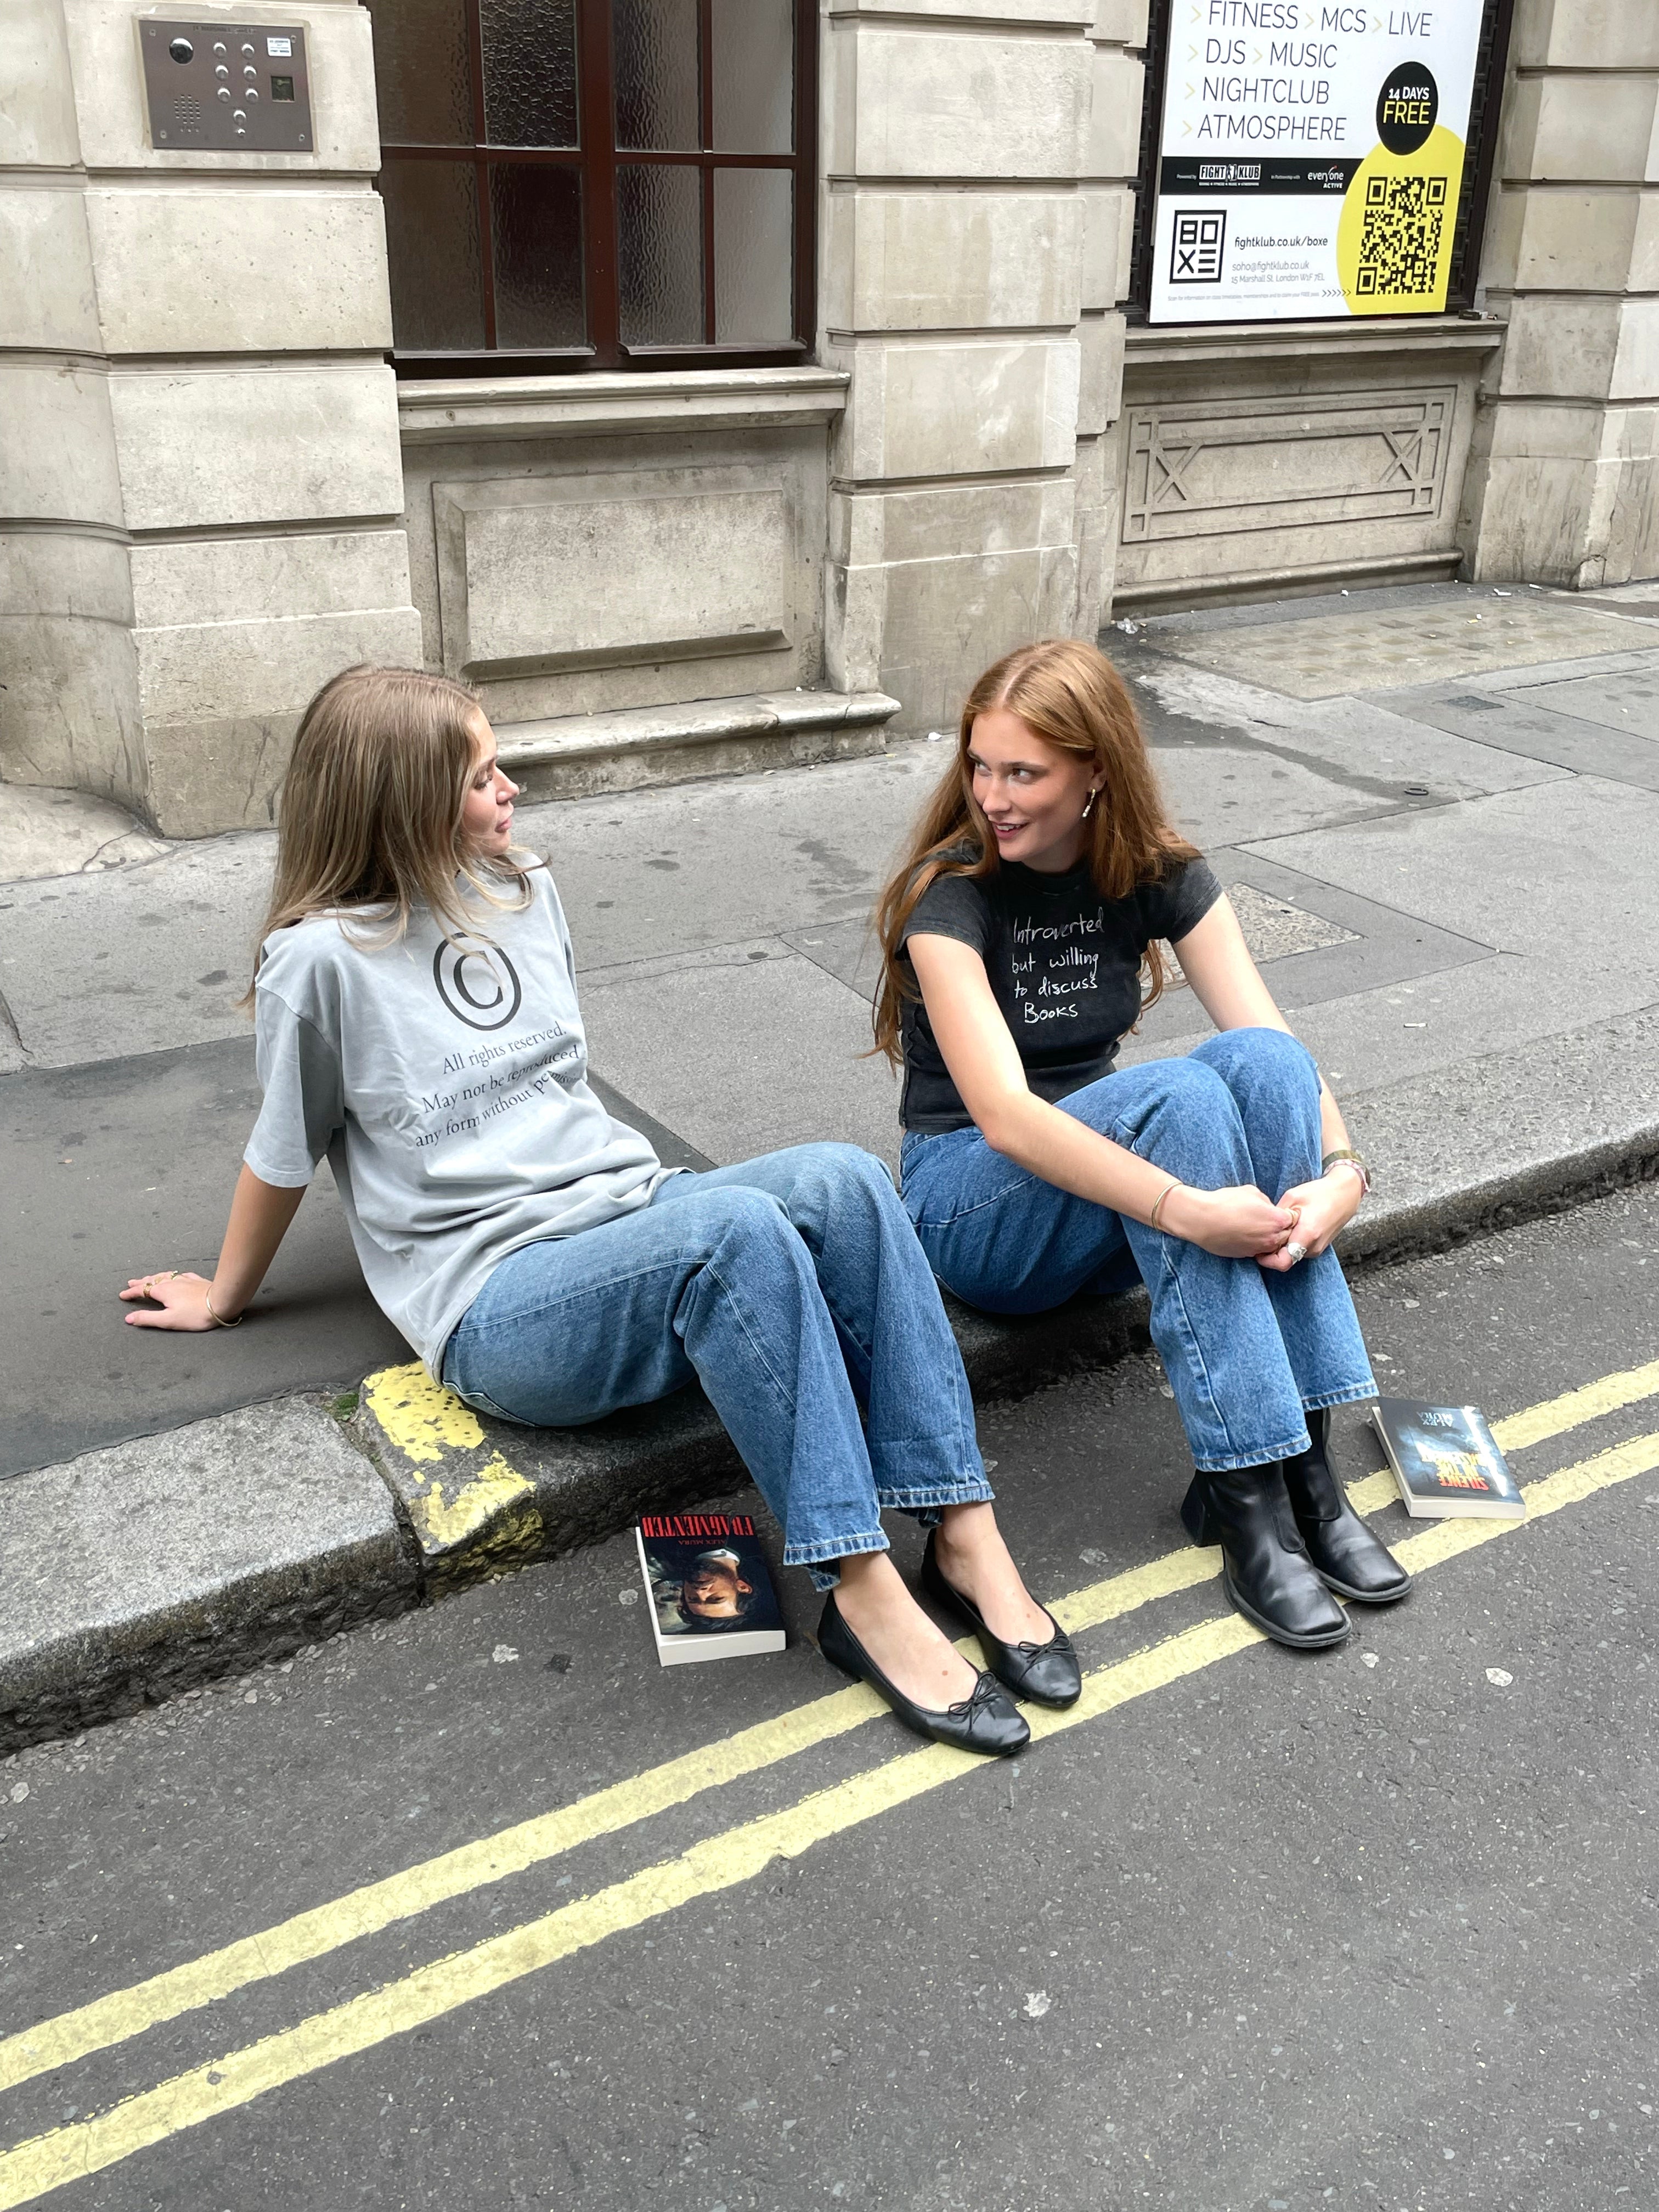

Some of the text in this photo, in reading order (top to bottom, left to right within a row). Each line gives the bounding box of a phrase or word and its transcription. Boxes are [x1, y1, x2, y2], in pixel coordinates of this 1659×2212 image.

[1209, 1, 1432, 37] FITNESS MCS LIVE
[1206, 39, 1337, 69] DJS MUSIC
[1203, 76, 1329, 104] NIGHTCLUB
[1389, 87, 1429, 100] 14 DAYS
[1383, 101, 1431, 125] FREE
[1198, 114, 1347, 140] ATMOSPHERE
[1200, 166, 1259, 178] FIGHT KLUB
[1308, 166, 1344, 183] everyone
[1235, 236, 1328, 250] fightklub.co.uk/boxe
[1232, 260, 1309, 272] soho@fightklub.co.uk
[1231, 276, 1238, 284] 15
[1239, 274, 1265, 283] Marshall
[1314, 273, 1324, 282] 7EL
[1013, 906, 1104, 944] Introverted
[1012, 946, 1098, 978] but willing
[1014, 977, 1098, 999] to discuss
[442, 1020, 567, 1075] All rights reserved.
[421, 1045, 579, 1114] May not be reproduced
[415, 1130, 442, 1147] any
[445, 1116, 479, 1137] form
[481, 1089, 534, 1120] without
[1438, 1474, 1489, 1491] SILENCE
[642, 1516, 753, 1537] FRAGMENTED
